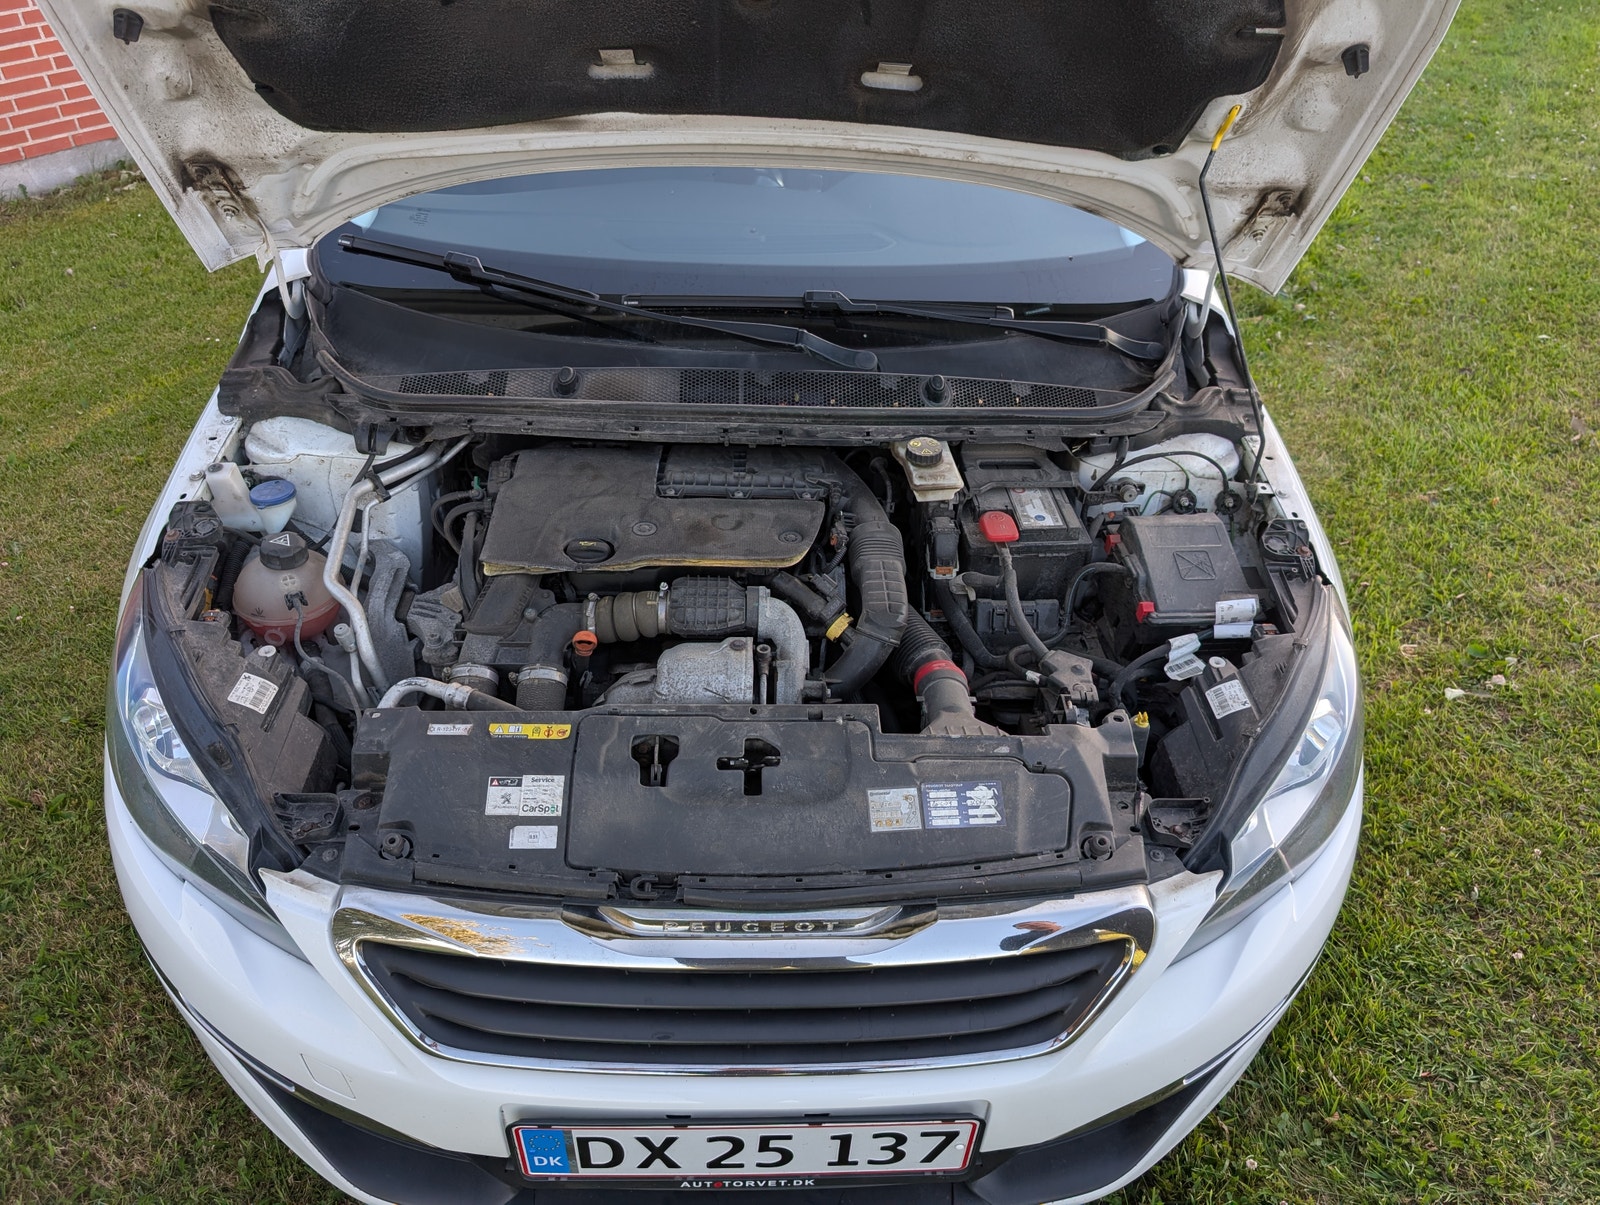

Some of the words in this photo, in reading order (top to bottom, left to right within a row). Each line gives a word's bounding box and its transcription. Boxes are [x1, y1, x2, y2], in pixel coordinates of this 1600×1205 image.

[521, 804, 559, 814] CarSpot
[663, 921, 839, 932] PEUGEOT
[575, 1135, 681, 1169] DX
[706, 1133, 794, 1169] 25
[827, 1130, 961, 1166] 137
[533, 1156, 564, 1167] DK
[680, 1179, 815, 1188] AUTOTORVET.DK
